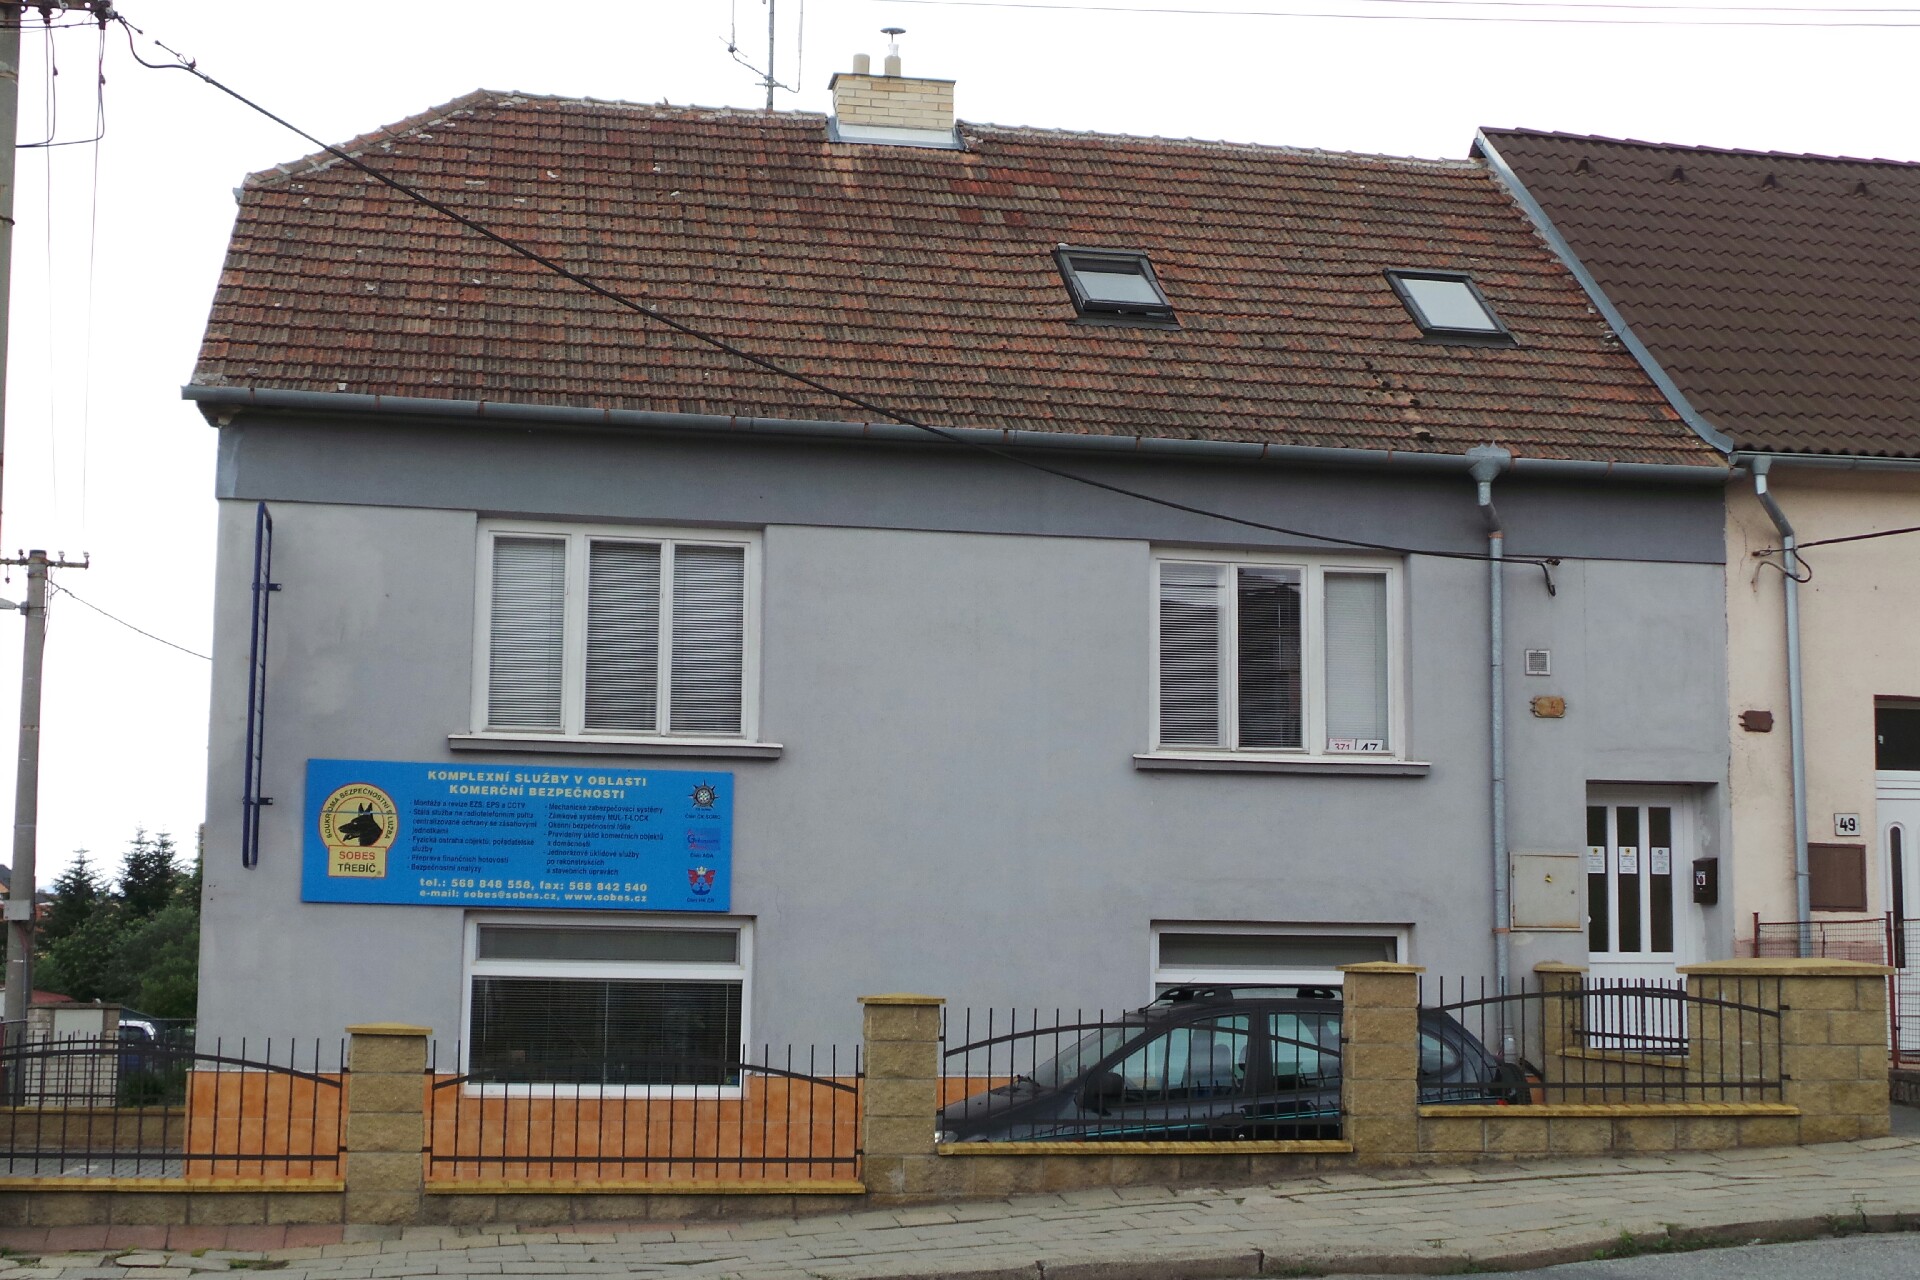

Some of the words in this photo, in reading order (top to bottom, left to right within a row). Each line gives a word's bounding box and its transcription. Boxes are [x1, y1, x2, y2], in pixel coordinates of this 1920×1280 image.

[428, 770, 510, 782] KOMPLEXNÍ
[515, 772, 569, 784] SLUŽBY
[575, 776, 583, 784] V
[588, 776, 647, 787] OBLASTI
[449, 784, 524, 796] KOMERČNÍ
[529, 785, 625, 799] BEZPEČNOSTI
[1840, 818, 1856, 831] 49
[339, 851, 375, 860] SOBES
[338, 863, 376, 872] TŘEBÍČ
[419, 878, 446, 887] tel.:
[451, 879, 474, 887] 568
[479, 879, 502, 888] 848
[507, 880, 534, 890] 558,
[539, 880, 564, 890] fax:
[569, 881, 592, 891] 568
[597, 882, 620, 891] 842
[624, 883, 647, 892] 540
[419, 889, 459, 898] e-mail:
[463, 890, 560, 901] sobes@sobes.cz,
[564, 893, 647, 902] www.sobes.cz
